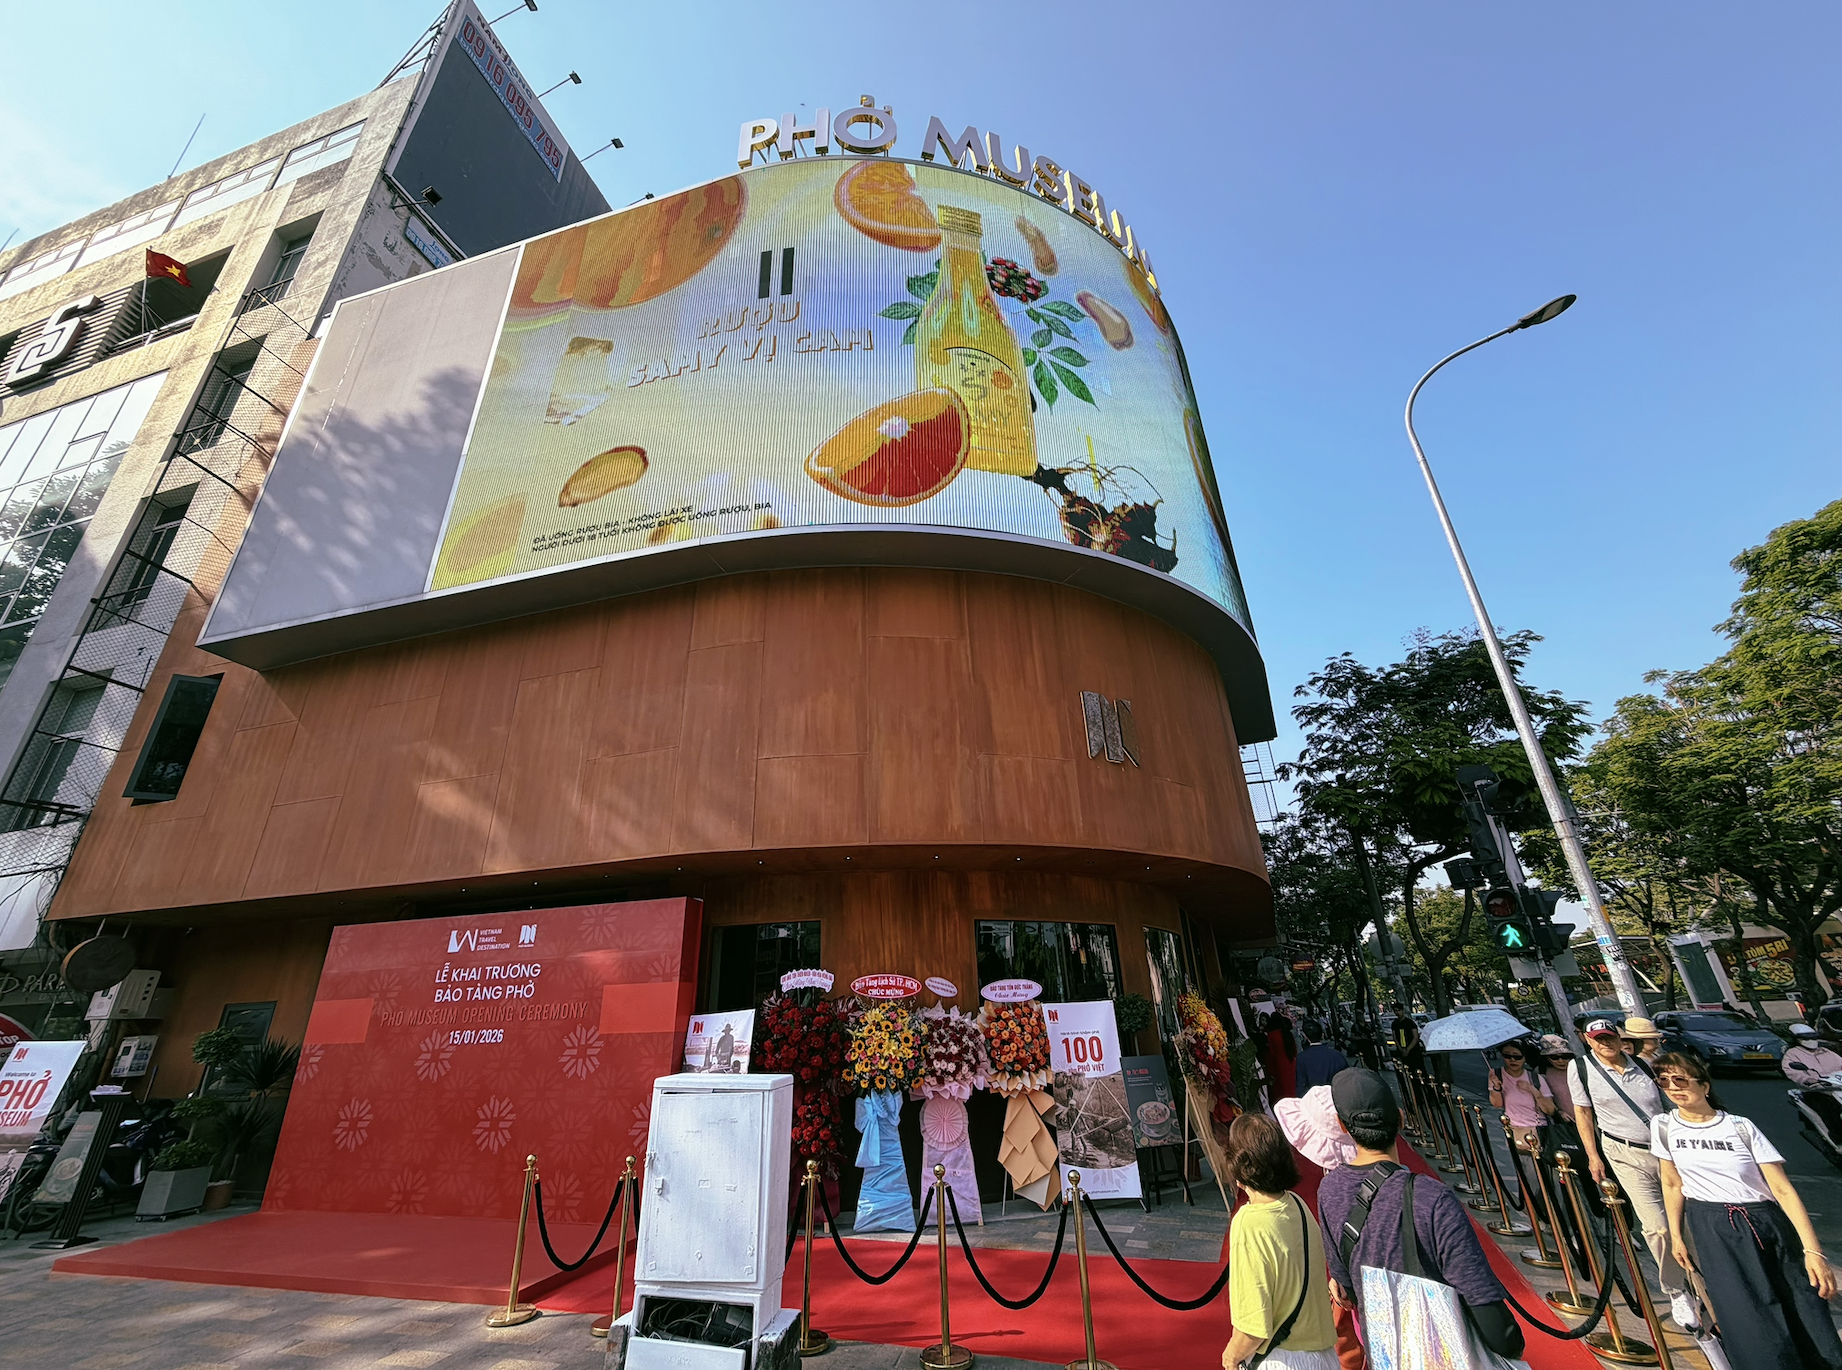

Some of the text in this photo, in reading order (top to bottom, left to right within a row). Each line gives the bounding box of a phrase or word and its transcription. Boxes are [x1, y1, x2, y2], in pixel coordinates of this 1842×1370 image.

[505, 82, 535, 130] 095
[535, 123, 564, 169] 795
[737, 94, 1162, 298] PHỞ MUSEUM
[604, 520, 619, 529] BIA
[628, 512, 661, 523] KHÔNG
[681, 505, 693, 513] XE
[622, 522, 656, 535] KHÔNG
[754, 502, 772, 510] BIA
[476, 943, 511, 951] DESTINATION
[435, 961, 541, 984] LỄ KHAI TRƯƠNG
[434, 980, 535, 1003] BẢO TÀNG PHỞ
[868, 987, 904, 997] CHÚC MỪNG
[905, 979, 918, 991] HCM
[407, 1007, 458, 1026] MUSEUM
[462, 1005, 515, 1023] OPENING
[519, 1001, 588, 1022] CEREMONY
[449, 1028, 505, 1045] 15/01/2026
[1062, 1036, 1103, 1064] 100
[0, 1070, 52, 1110] PHỞ
[0, 1111, 33, 1127] SEUM
[1675, 1138, 1735, 1152] JE T'AIME
